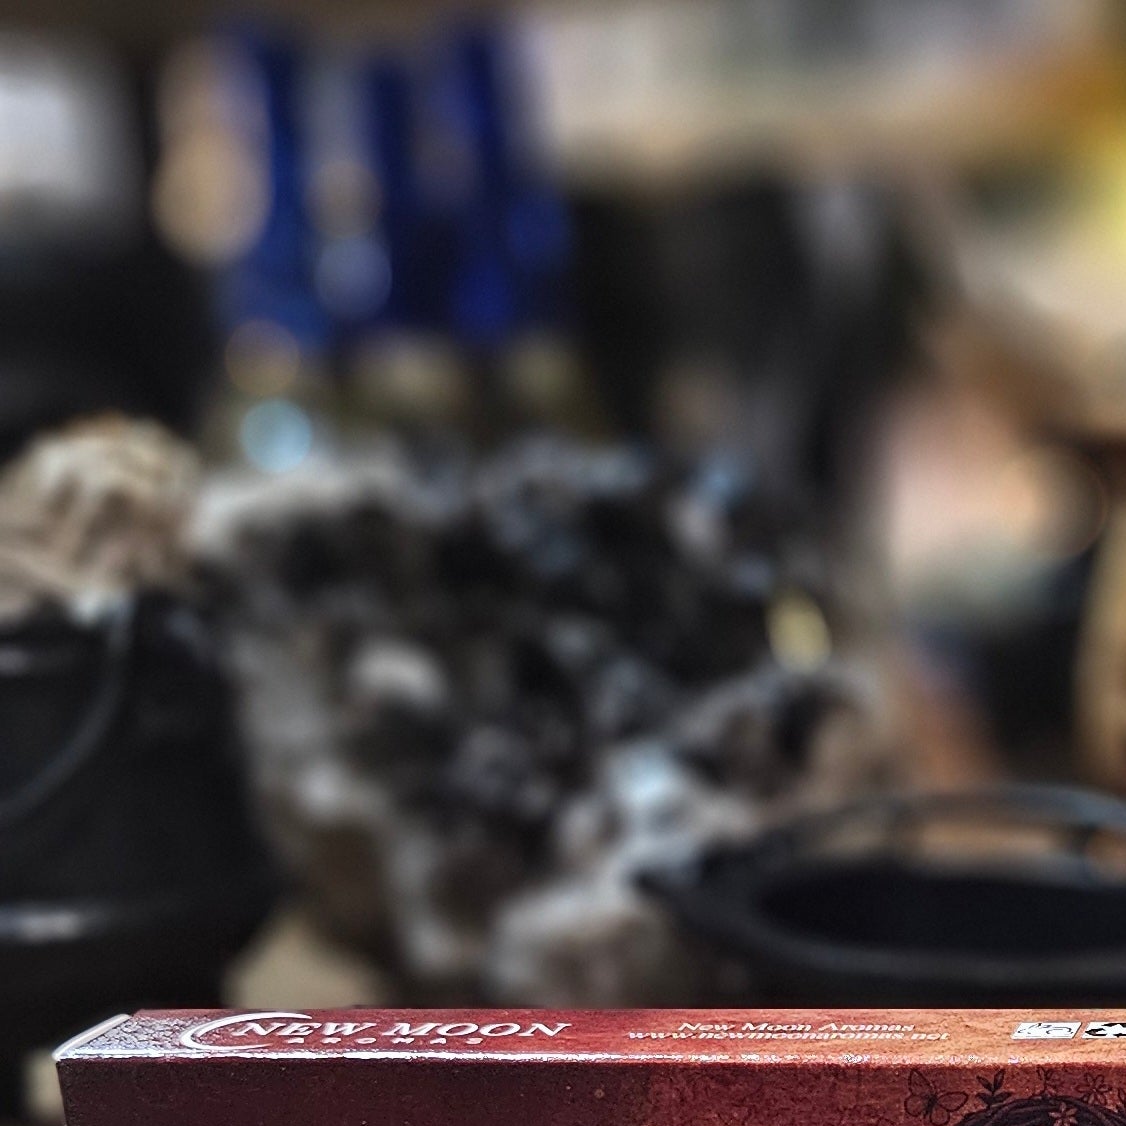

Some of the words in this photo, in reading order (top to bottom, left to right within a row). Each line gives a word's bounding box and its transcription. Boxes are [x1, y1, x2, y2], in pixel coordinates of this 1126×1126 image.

[231, 1022, 377, 1036] NEW
[382, 1022, 572, 1036] MOON
[678, 1023, 735, 1031] New
[742, 1023, 812, 1031] Moon
[819, 1023, 914, 1031] Aromas
